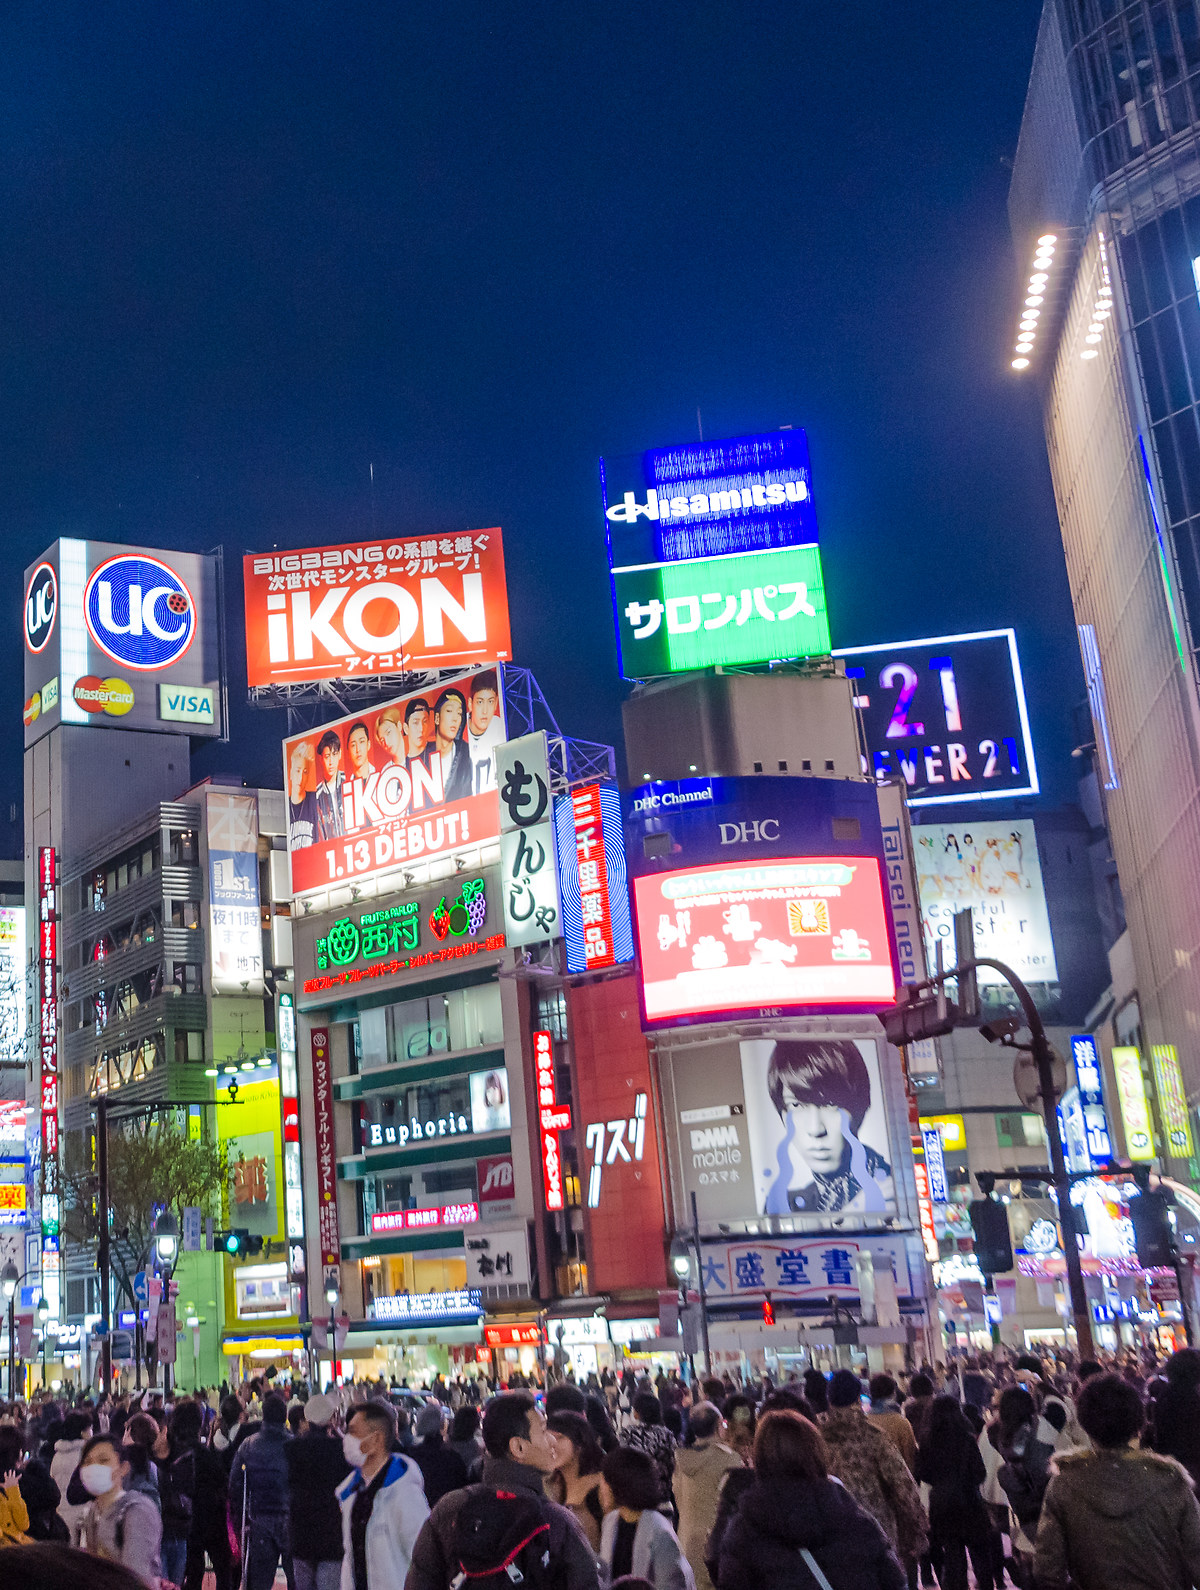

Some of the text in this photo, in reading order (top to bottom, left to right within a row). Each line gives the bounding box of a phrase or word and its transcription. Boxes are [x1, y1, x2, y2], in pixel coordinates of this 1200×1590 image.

[606, 479, 809, 524] Hisamitsu
[267, 572, 488, 664] iKON
[625, 580, 817, 640] サロンパス
[345, 652, 412, 672] アイコン
[42, 685, 58, 706] VISA
[74, 686, 134, 704] MasterCard
[167, 694, 212, 714] VISA
[861, 736, 1021, 787] EVER 21
[342, 752, 444, 834] iKON
[633, 786, 713, 813] DHC Channel
[207, 796, 257, 853] 本
[378, 818, 408, 834] アイコン
[718, 818, 781, 846] DHC
[325, 810, 470, 879] 1.13 DEBUT!
[500, 760, 557, 934] もんじゃ
[572, 794, 609, 959] 三千里薬品
[213, 908, 258, 927] 夜11時
[881, 818, 917, 985] Taisei neo
[223, 930, 249, 945] まで
[316, 937, 328, 970] 渋谷
[361, 915, 419, 960] 西村
[237, 955, 260, 972] 地下
[759, 1007, 783, 1017] DHC
[315, 1059, 333, 1191] ウィンターフルーツギフト
[369, 1111, 469, 1146] Euphoria
[689, 1124, 740, 1151] DMM
[692, 1146, 742, 1169] mobile
[482, 1161, 513, 1193] JTB
[698, 1168, 740, 1186] のスマホ
[701, 1246, 898, 1292] 大盛堂書
